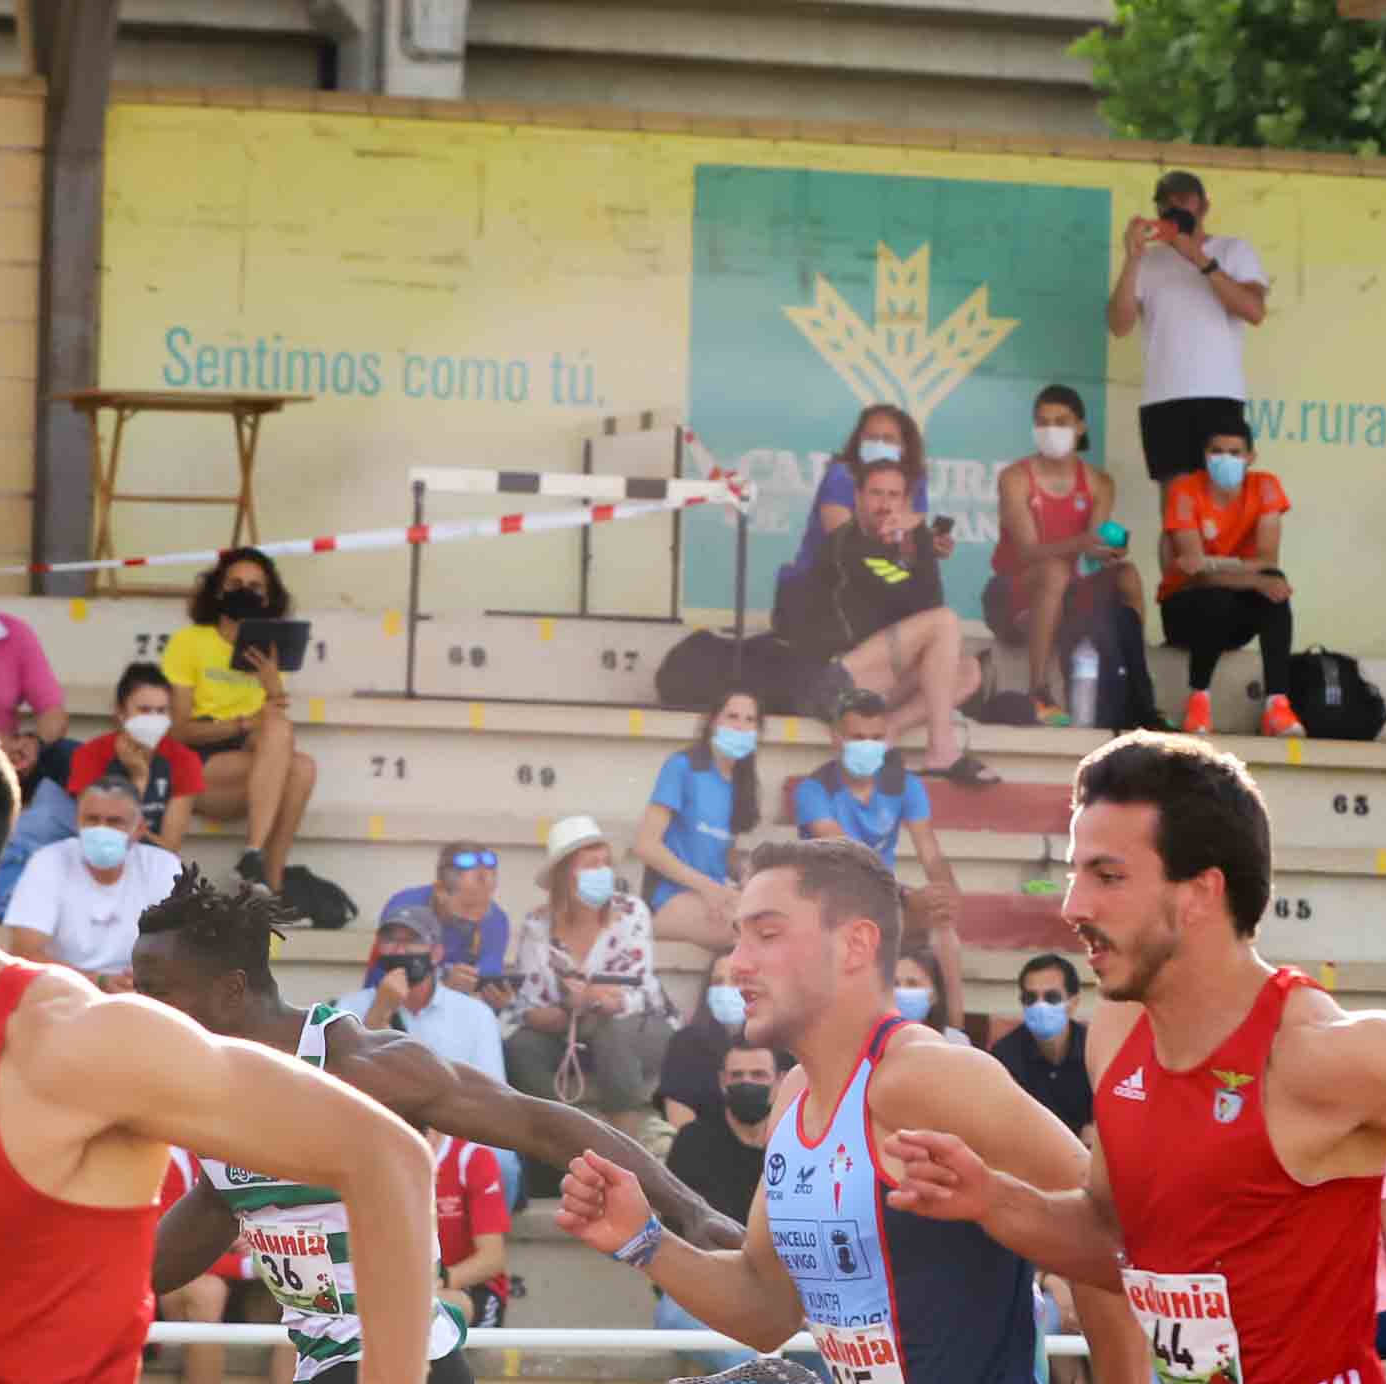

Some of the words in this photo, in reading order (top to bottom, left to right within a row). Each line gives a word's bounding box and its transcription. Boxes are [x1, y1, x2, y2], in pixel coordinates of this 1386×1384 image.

[162, 325, 382, 397] Sentimos
[403, 352, 530, 402] como
[550, 347, 606, 407] tú.
[1246, 681, 1262, 701] 6
[370, 755, 406, 780] 71
[516, 764, 556, 788] 69
[1274, 899, 1312, 920] 65
[773, 1231, 817, 1249] ONCELLO
[261, 1254, 303, 1291] 36
[1128, 1278, 1228, 1319] edunia
[1152, 1319, 1195, 1371] 44
